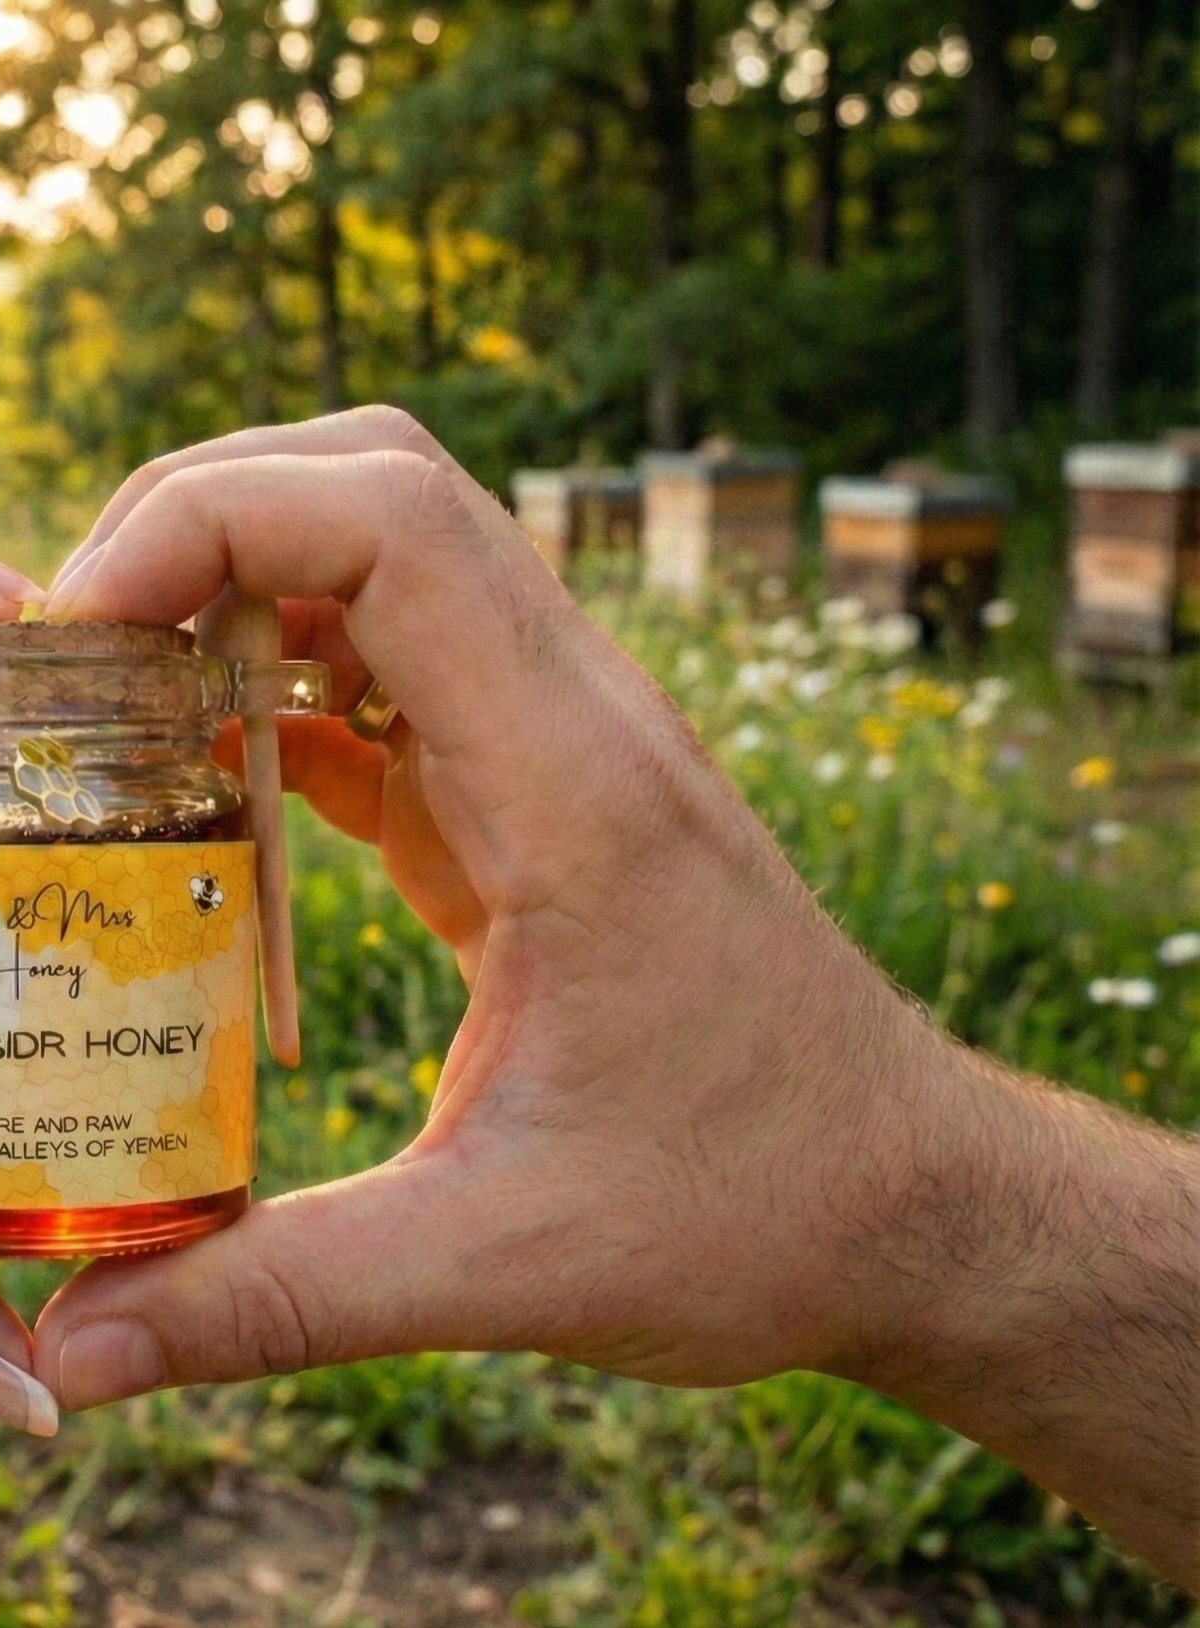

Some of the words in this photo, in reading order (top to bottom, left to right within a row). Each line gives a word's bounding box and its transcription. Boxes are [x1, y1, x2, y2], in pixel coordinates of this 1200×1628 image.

[7, 897, 36, 930] &
[32, 882, 137, 942] Mrs
[86, 1023, 205, 1059] HONEY
[34, 1116, 78, 1134] AND
[86, 1114, 133, 1133] RAW
[86, 1139, 114, 1157] OF
[123, 1133, 187, 1155] YEMEN
